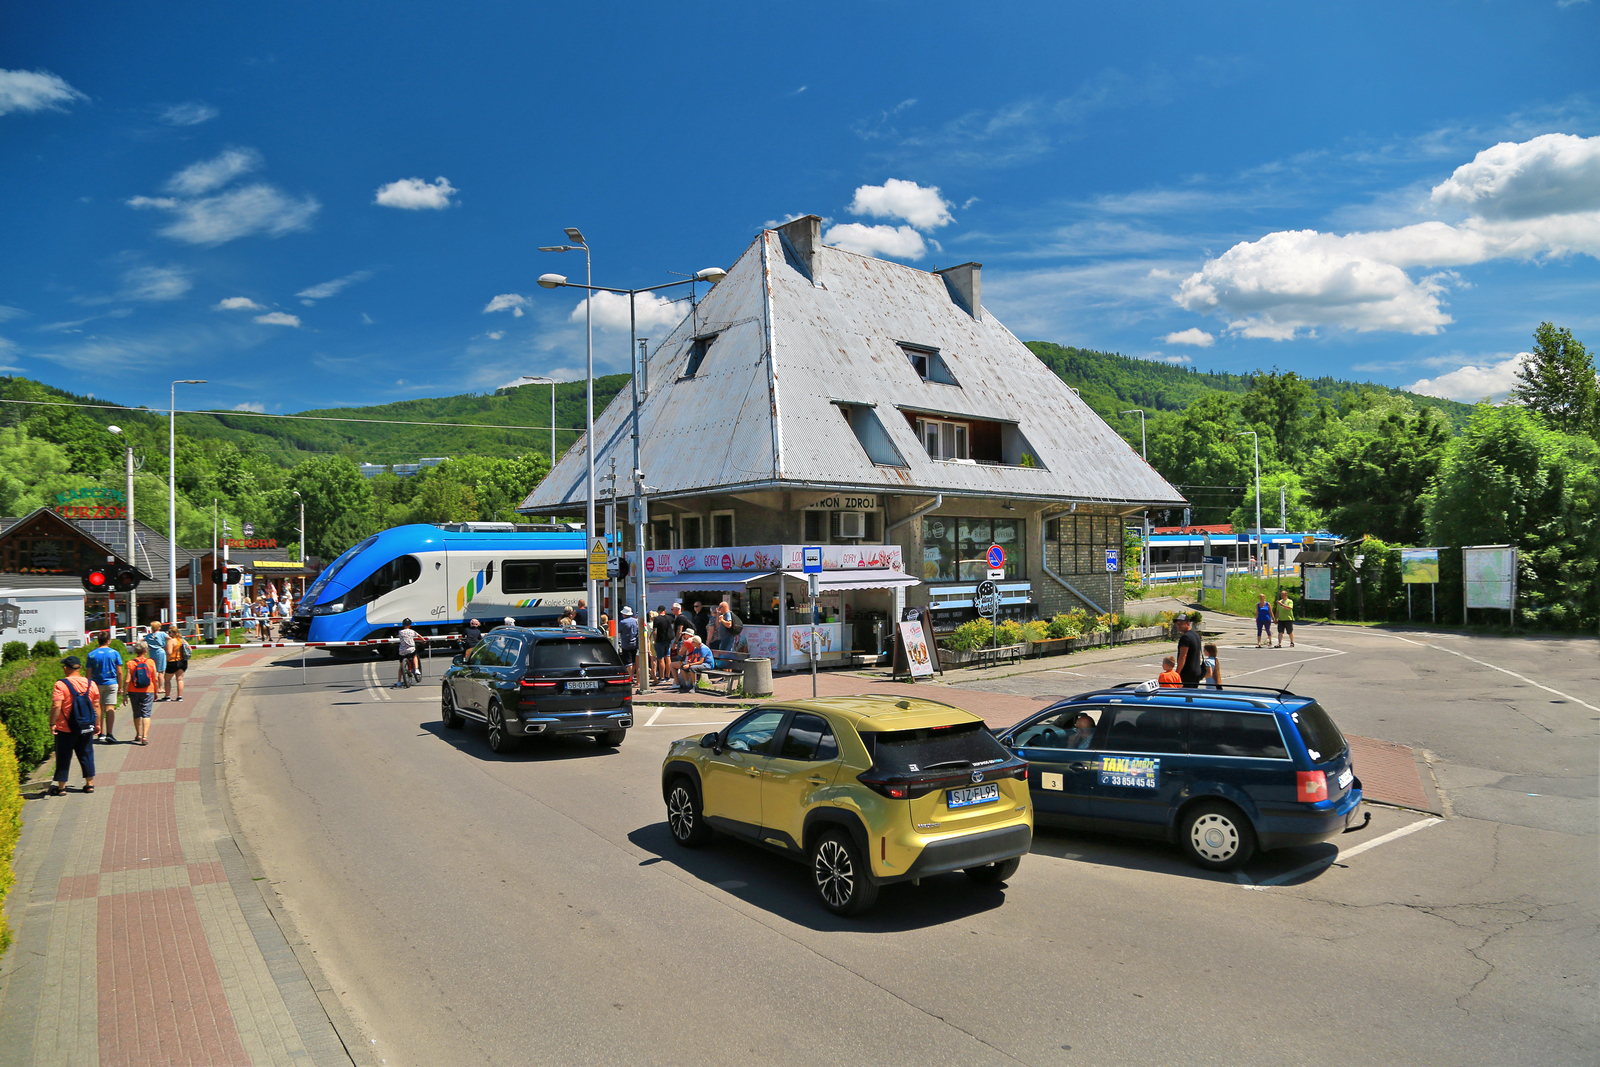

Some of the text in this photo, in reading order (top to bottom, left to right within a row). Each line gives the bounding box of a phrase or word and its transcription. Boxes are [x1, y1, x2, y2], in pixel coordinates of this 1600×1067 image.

[55, 487, 127, 504] KARCZM
[845, 495, 874, 508] ZDRÓJ
[220, 539, 277, 548] BROWAR
[658, 554, 671, 566] LODY
[704, 555, 720, 567] GOFRY
[792, 551, 803, 562] LOD
[842, 553, 857, 564] GOFRY
[544, 597, 579, 607] Koleje Śląski
[28, 627, 45, 635] 6,640
[579, 680, 597, 688] 015FL
[1102, 757, 1129, 772] TAXI
[1111, 776, 1156, 788] 33 854 45 45
[954, 789, 972, 803] SJZ
[973, 785, 997, 800] FL95
